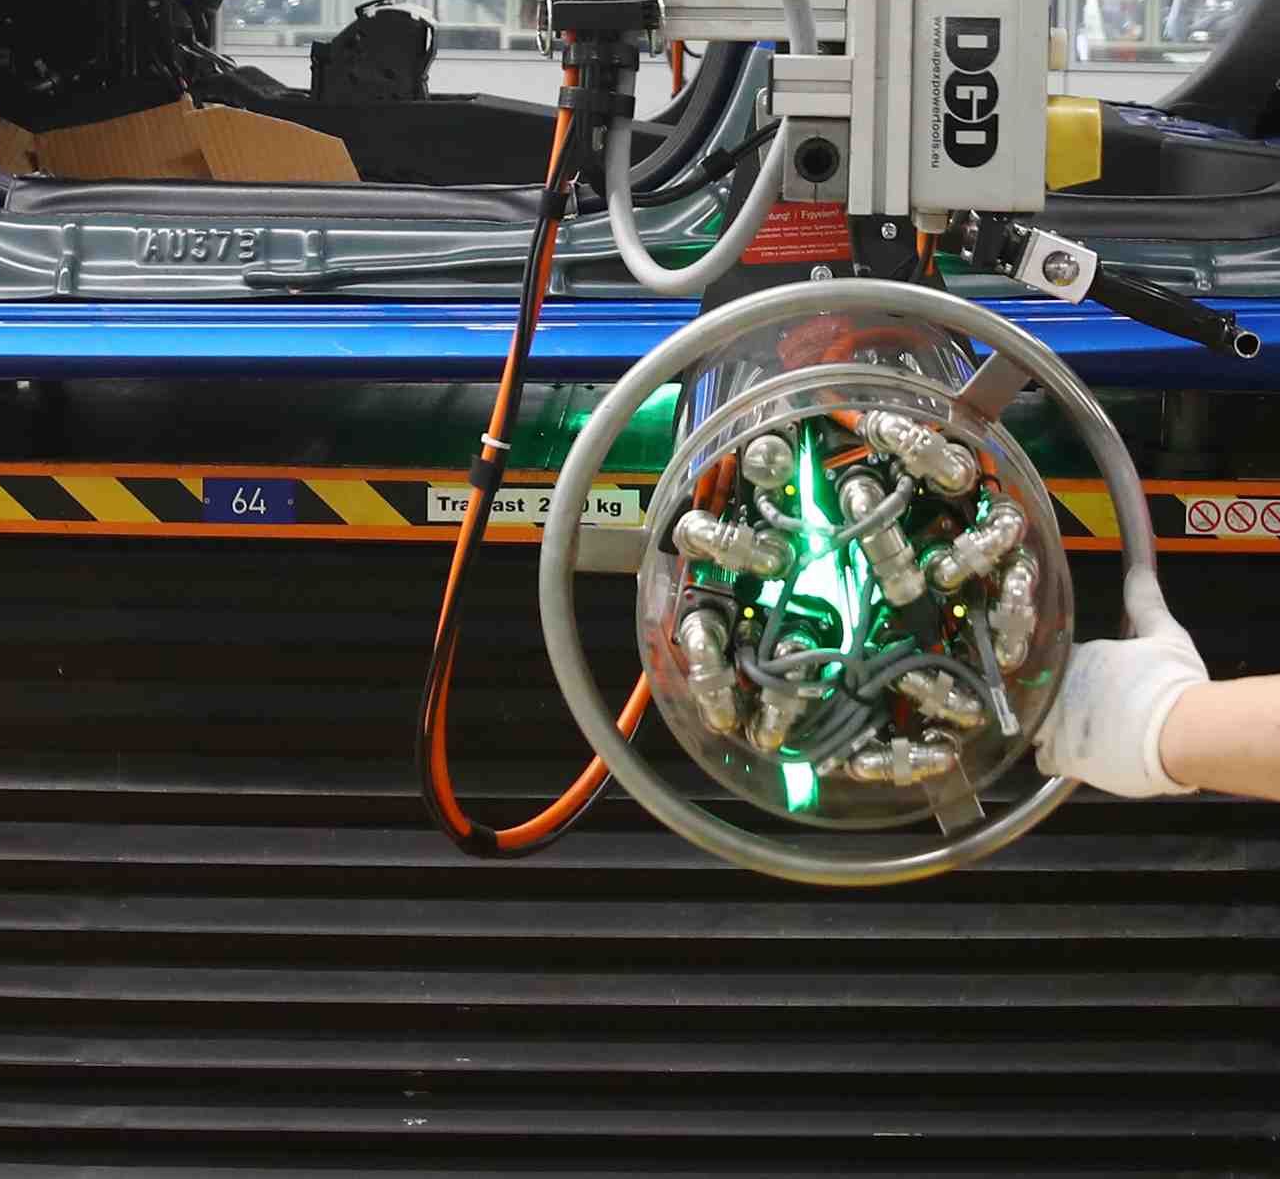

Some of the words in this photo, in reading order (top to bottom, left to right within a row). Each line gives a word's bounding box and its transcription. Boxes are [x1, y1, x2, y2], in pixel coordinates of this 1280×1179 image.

[931, 16, 942, 169] www.apexpowertools.eu
[943, 17, 1001, 168] DGD
[232, 487, 267, 515] 64
[437, 496, 526, 513] Traast
[596, 498, 622, 517] kg
